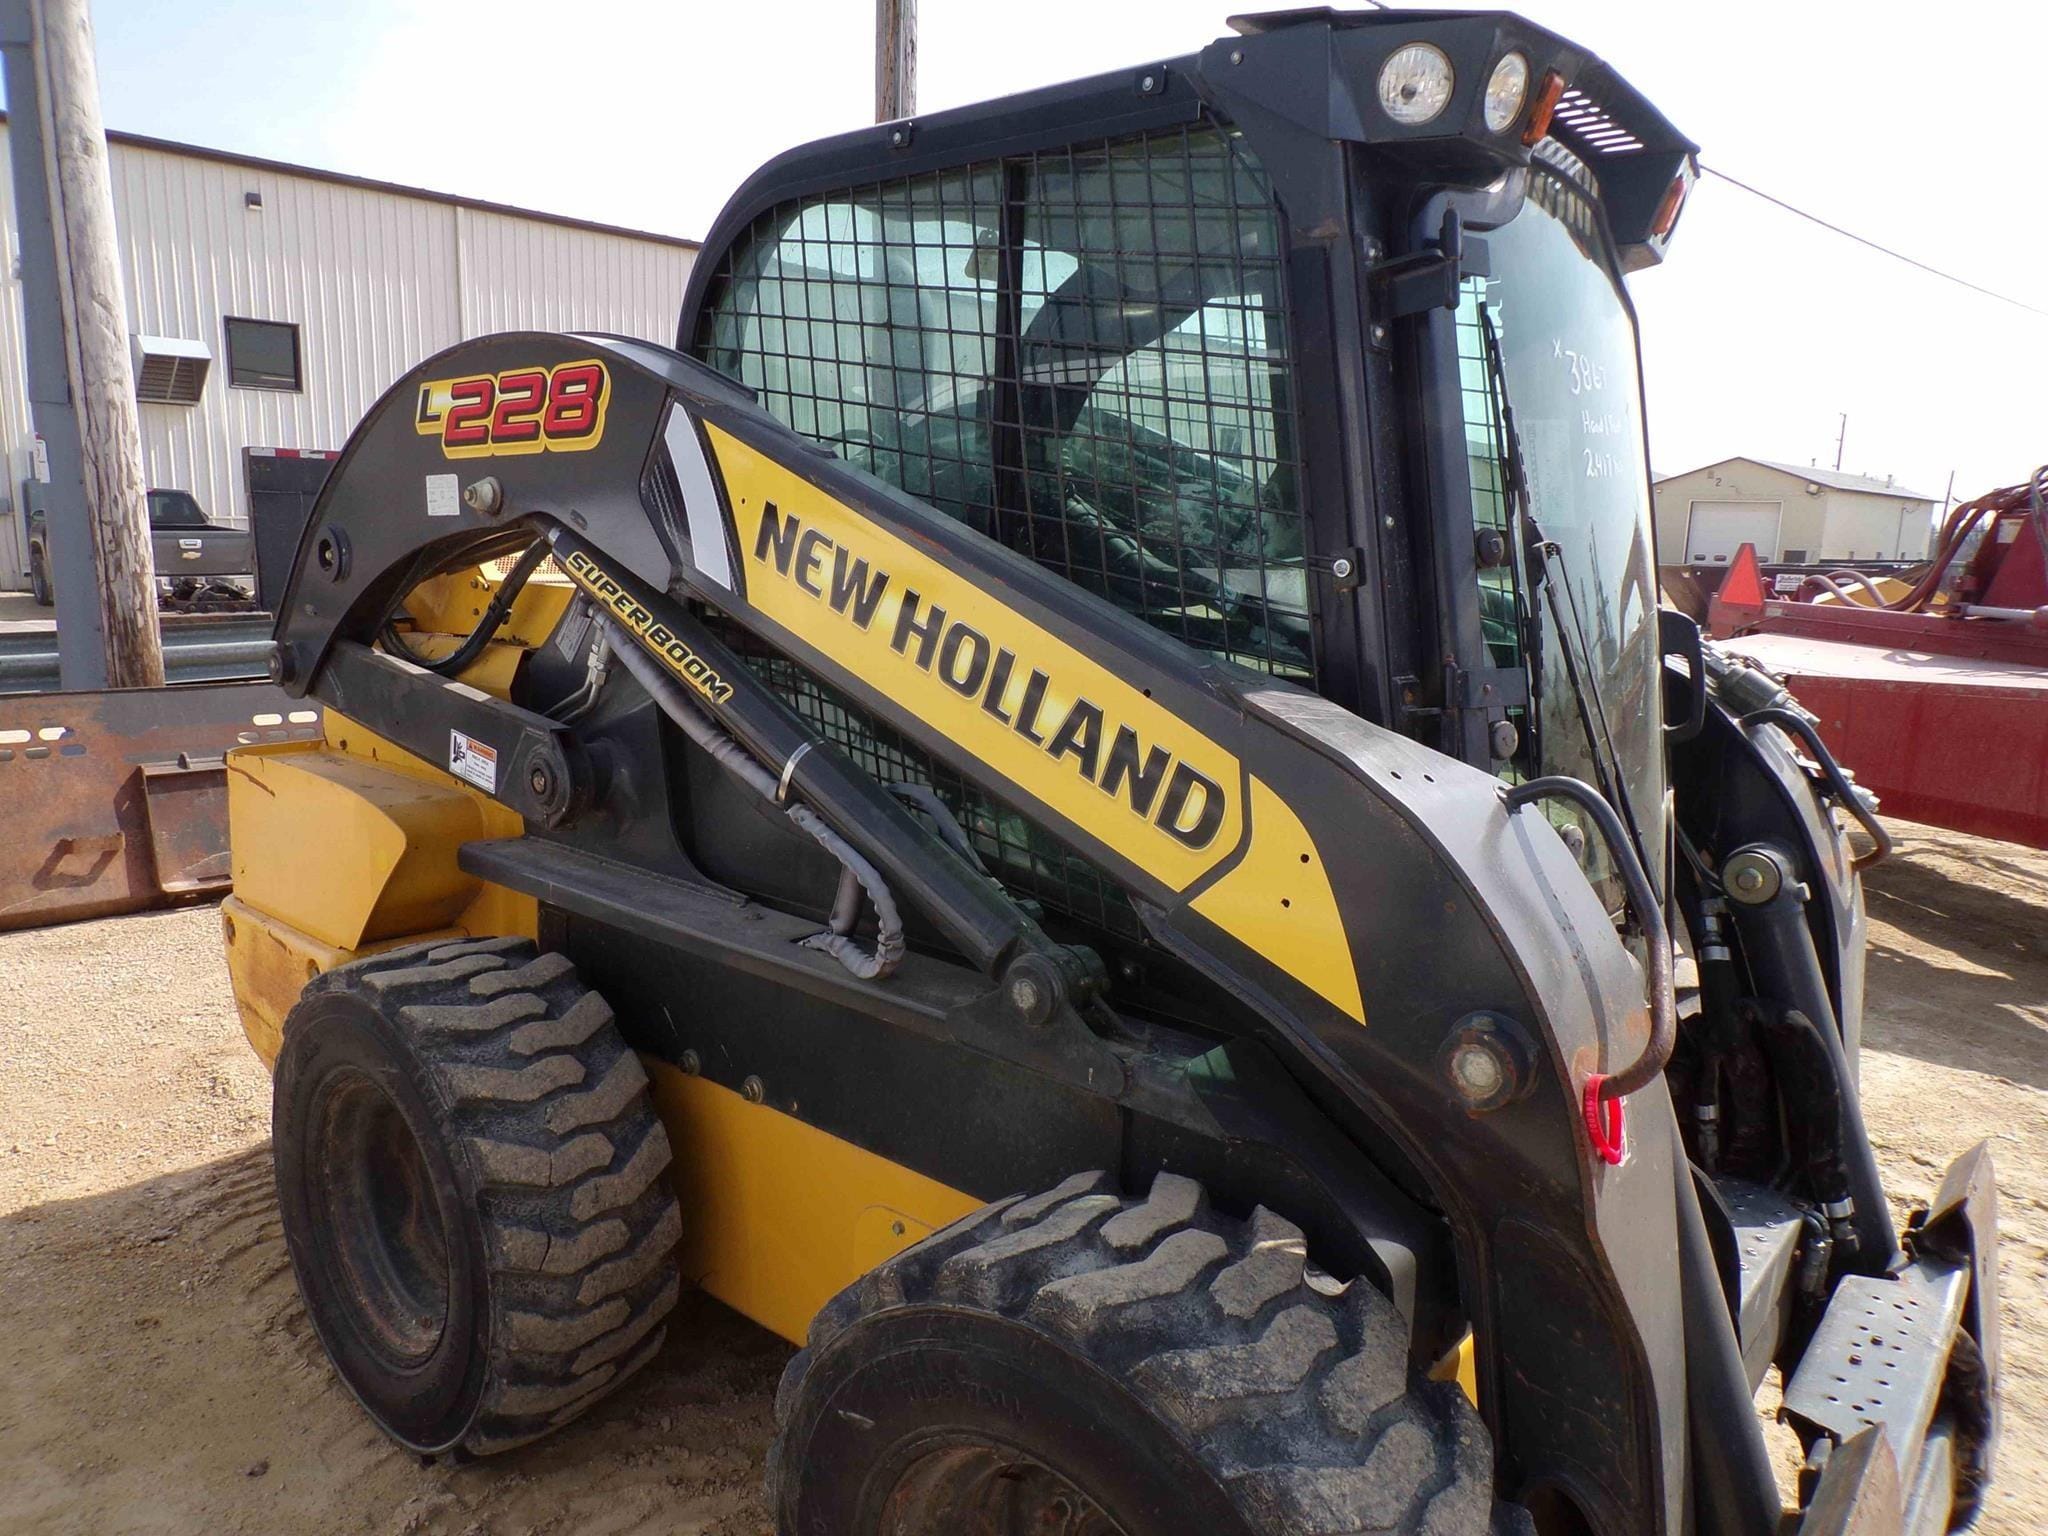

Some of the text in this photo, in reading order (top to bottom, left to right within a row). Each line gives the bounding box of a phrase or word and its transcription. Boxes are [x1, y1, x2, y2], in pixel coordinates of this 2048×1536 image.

[416, 361, 609, 453] L228
[754, 500, 1226, 851] NEW HOLLAND
